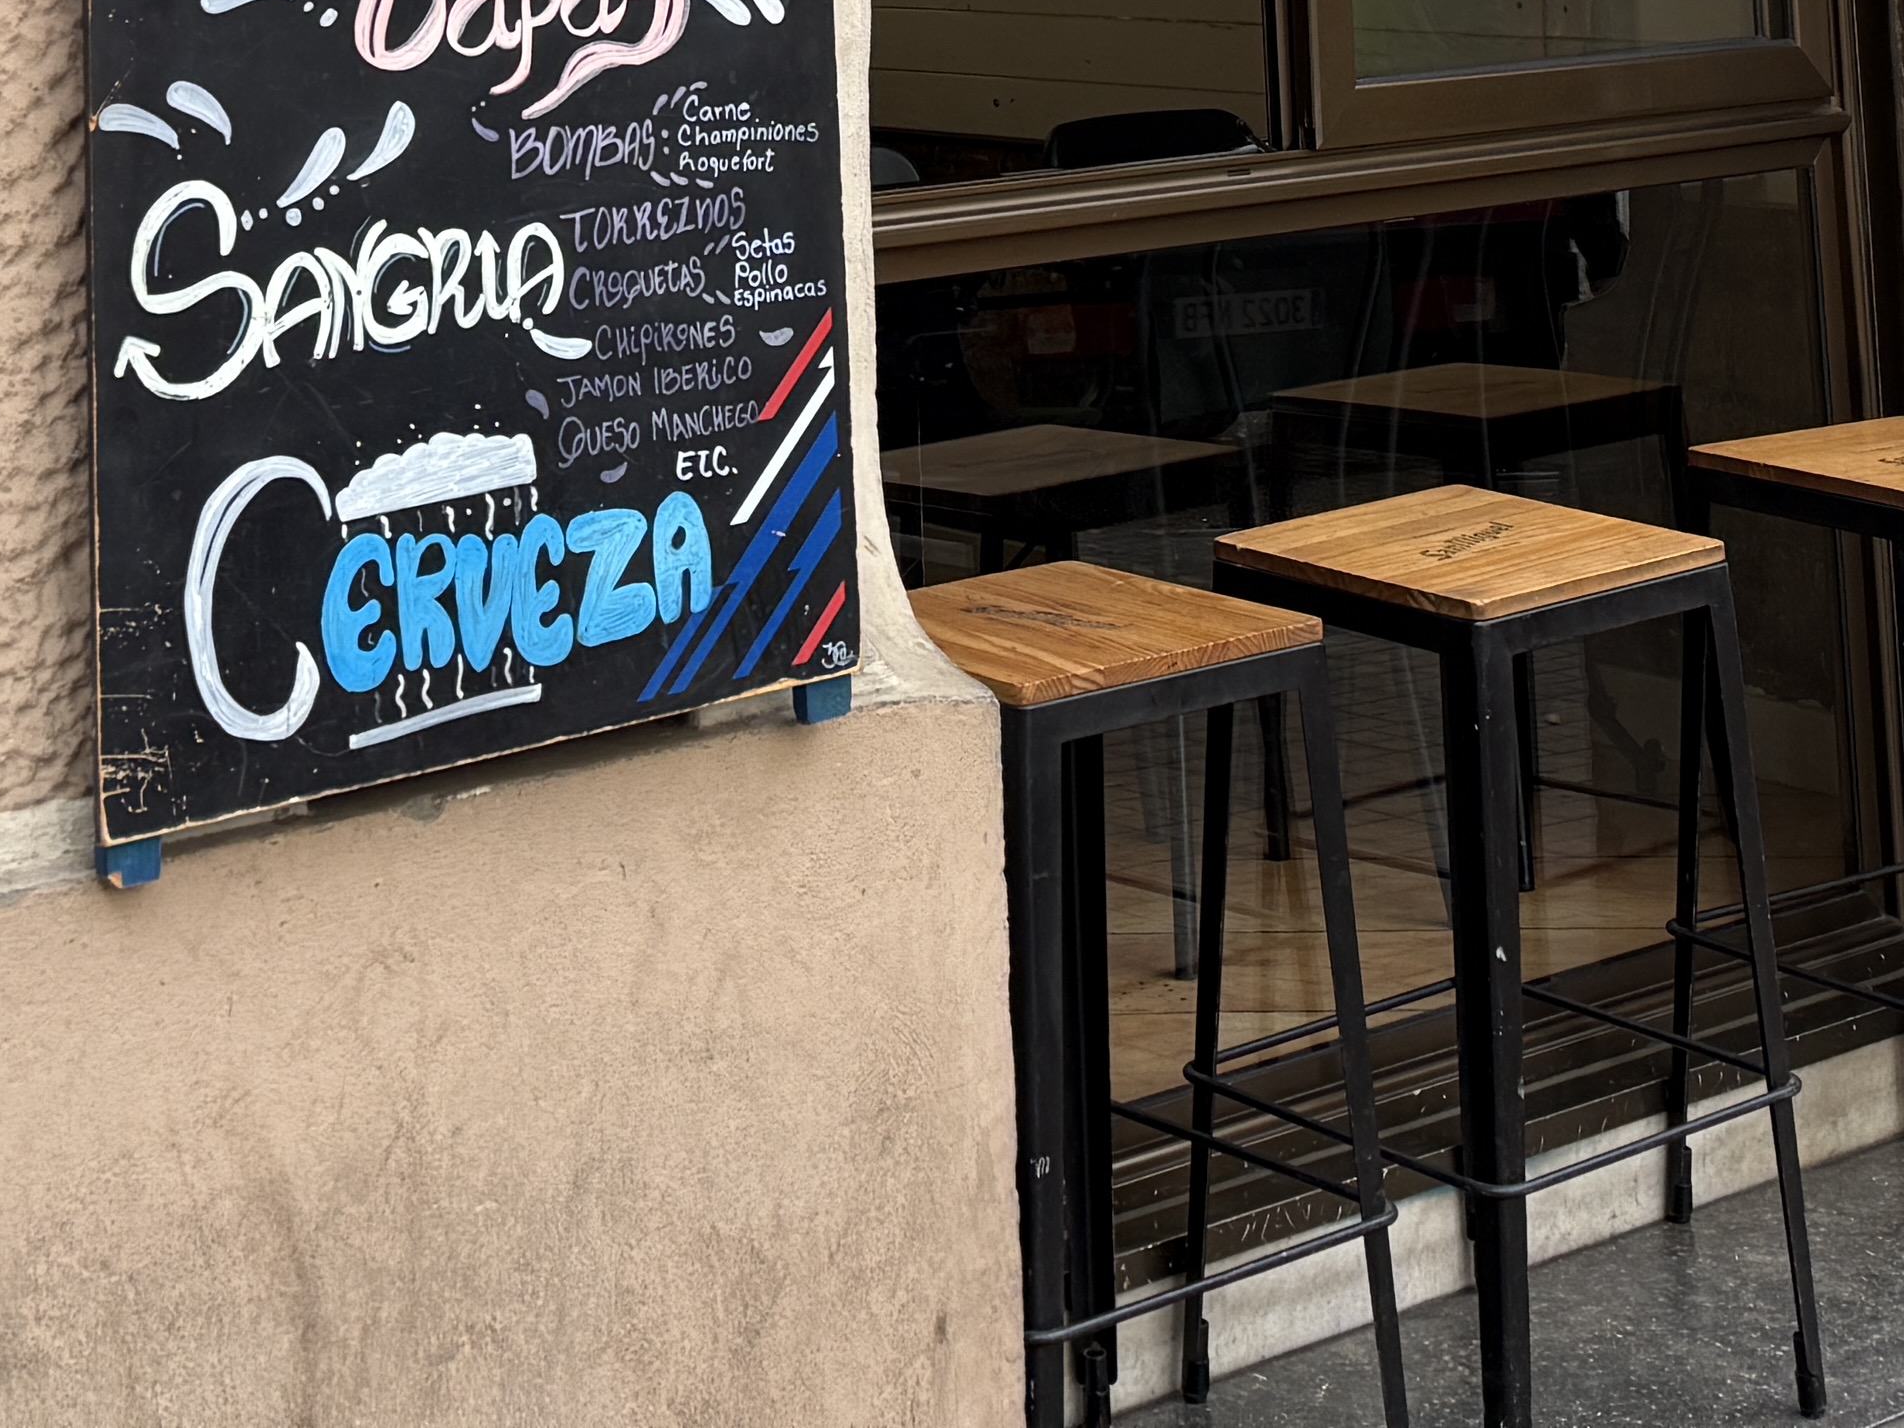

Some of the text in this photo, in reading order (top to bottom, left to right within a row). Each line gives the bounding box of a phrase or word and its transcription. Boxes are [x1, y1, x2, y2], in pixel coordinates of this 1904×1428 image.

[682, 93, 752, 123] Carne
[731, 229, 797, 262] Setas
[733, 260, 789, 291] Pollo
[556, 370, 642, 409] JAMON
[557, 397, 761, 469] QUESO MANCHEGO
